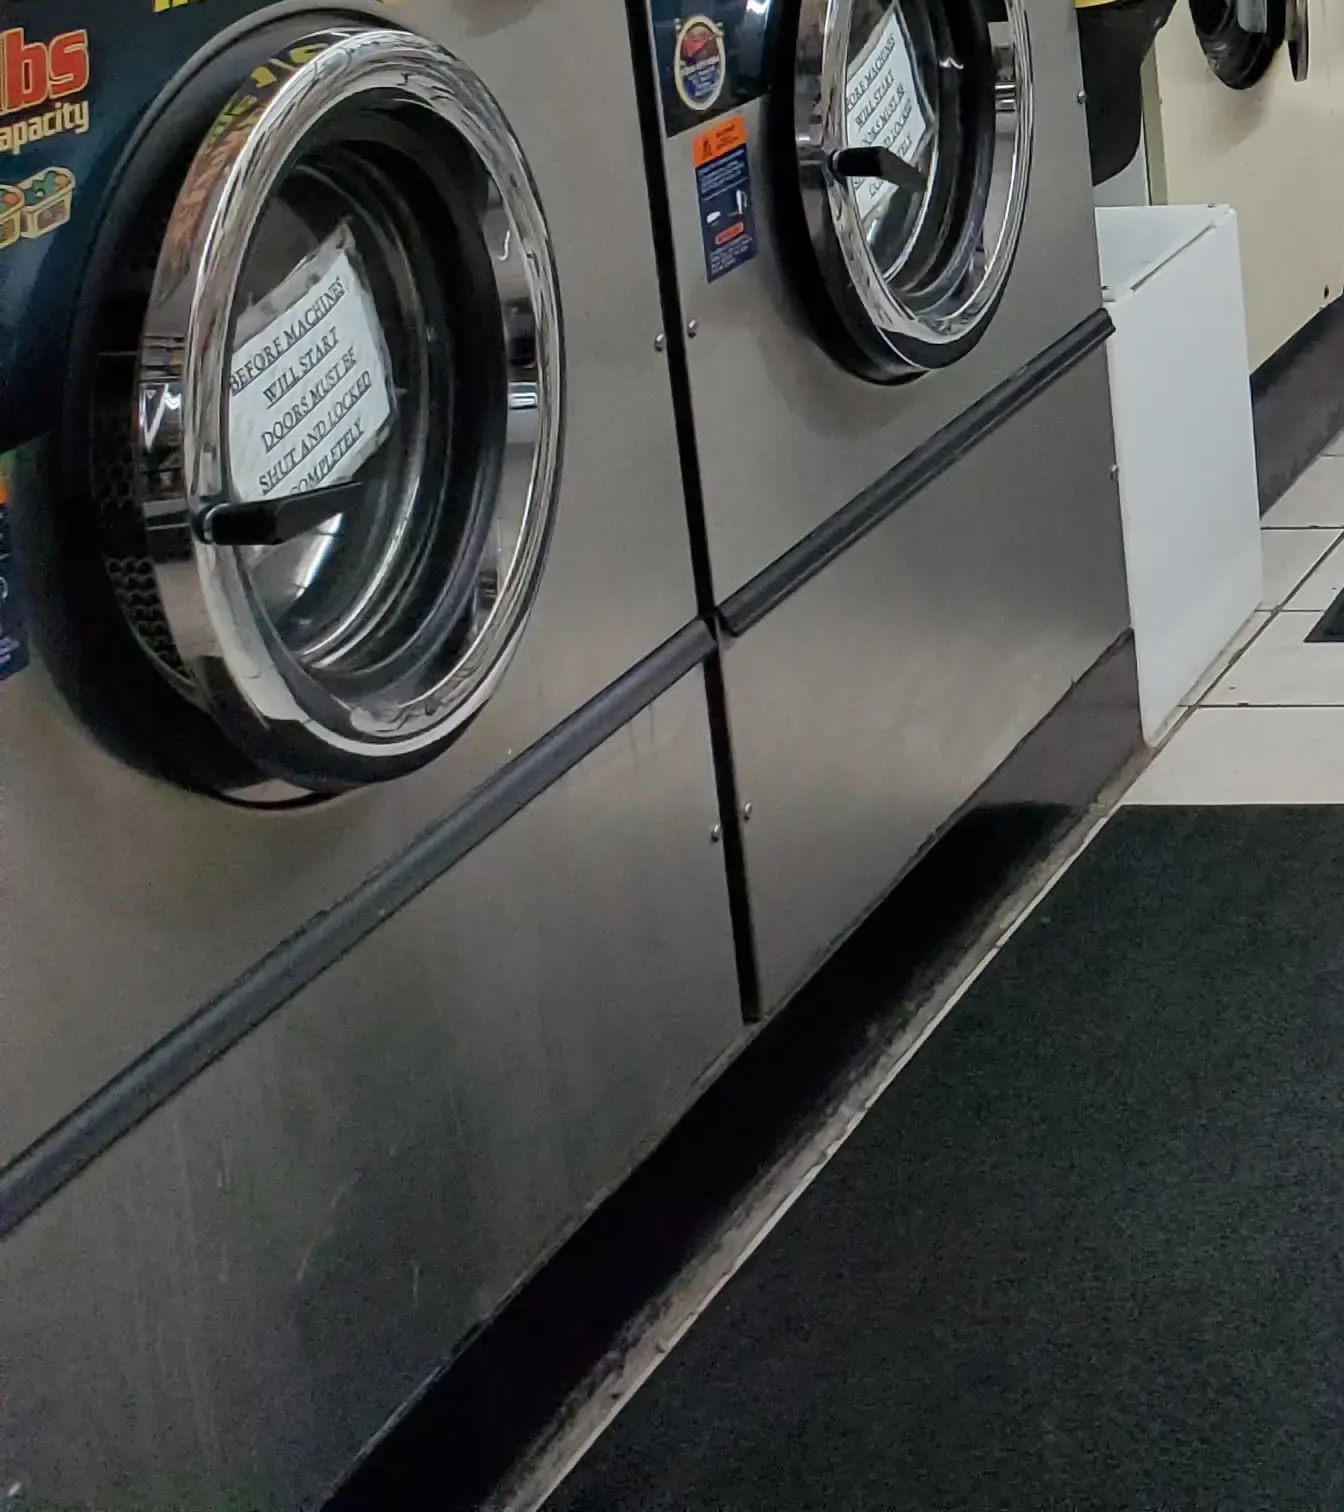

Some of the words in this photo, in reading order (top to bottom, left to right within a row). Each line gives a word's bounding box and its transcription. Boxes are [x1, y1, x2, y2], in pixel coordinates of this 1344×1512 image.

[854, 101, 875, 127] WILL
[873, 68, 896, 105] START
[864, 33, 896, 84] MACHINES
[0, 98, 90, 156] apacity
[229, 335, 284, 393] BEFORE
[283, 276, 347, 342] MACHINES
[262, 370, 301, 404] WILL
[299, 326, 340, 374] START
[258, 446, 298, 494] SHUT
[301, 417, 327, 455] AND
[328, 370, 373, 426] LOCKED
[260, 395, 310, 453] DOORS
[309, 368, 343, 410] MUST
[342, 345, 358, 376] BE
[290, 416, 365, 496] COMPLETELY
